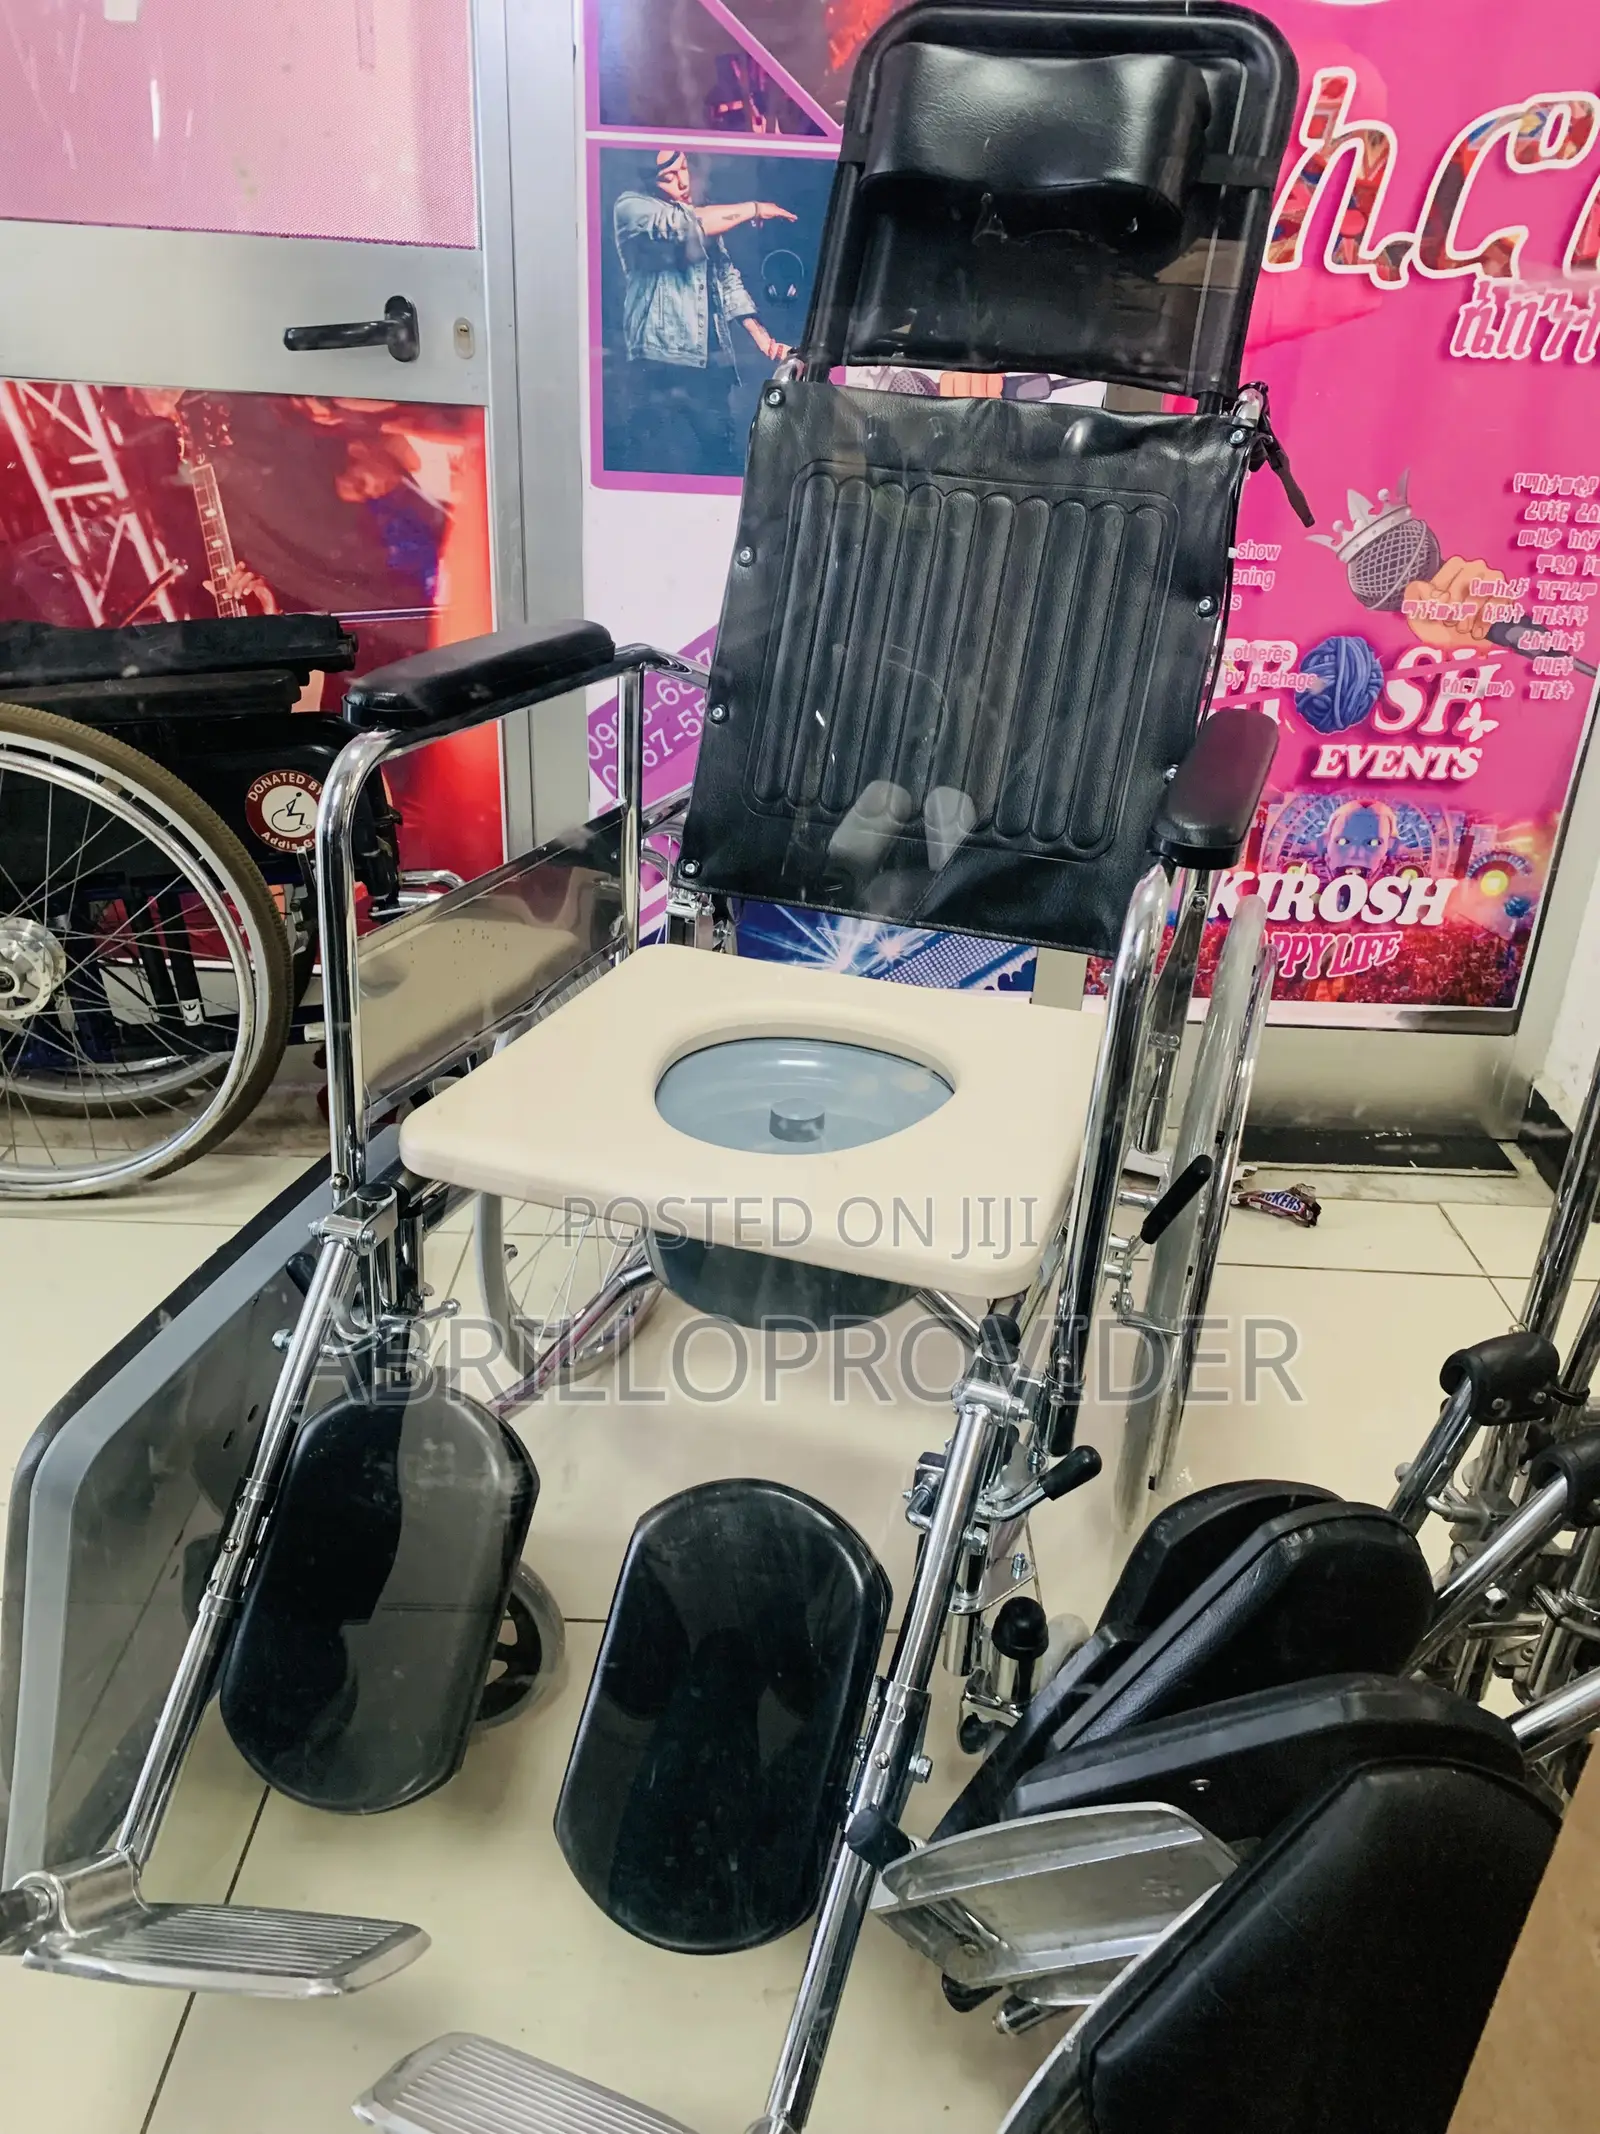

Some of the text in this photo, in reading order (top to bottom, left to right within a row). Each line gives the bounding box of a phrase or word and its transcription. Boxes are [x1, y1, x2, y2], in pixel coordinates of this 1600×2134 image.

[1237, 539, 1281, 561] show
[1224, 668, 1245, 690] by
[1311, 743, 1484, 781] EVENTS
[247, 772, 306, 802] DONATED
[1208, 870, 1459, 926] KIROSH
[1326, 930, 1404, 978] LIFE
